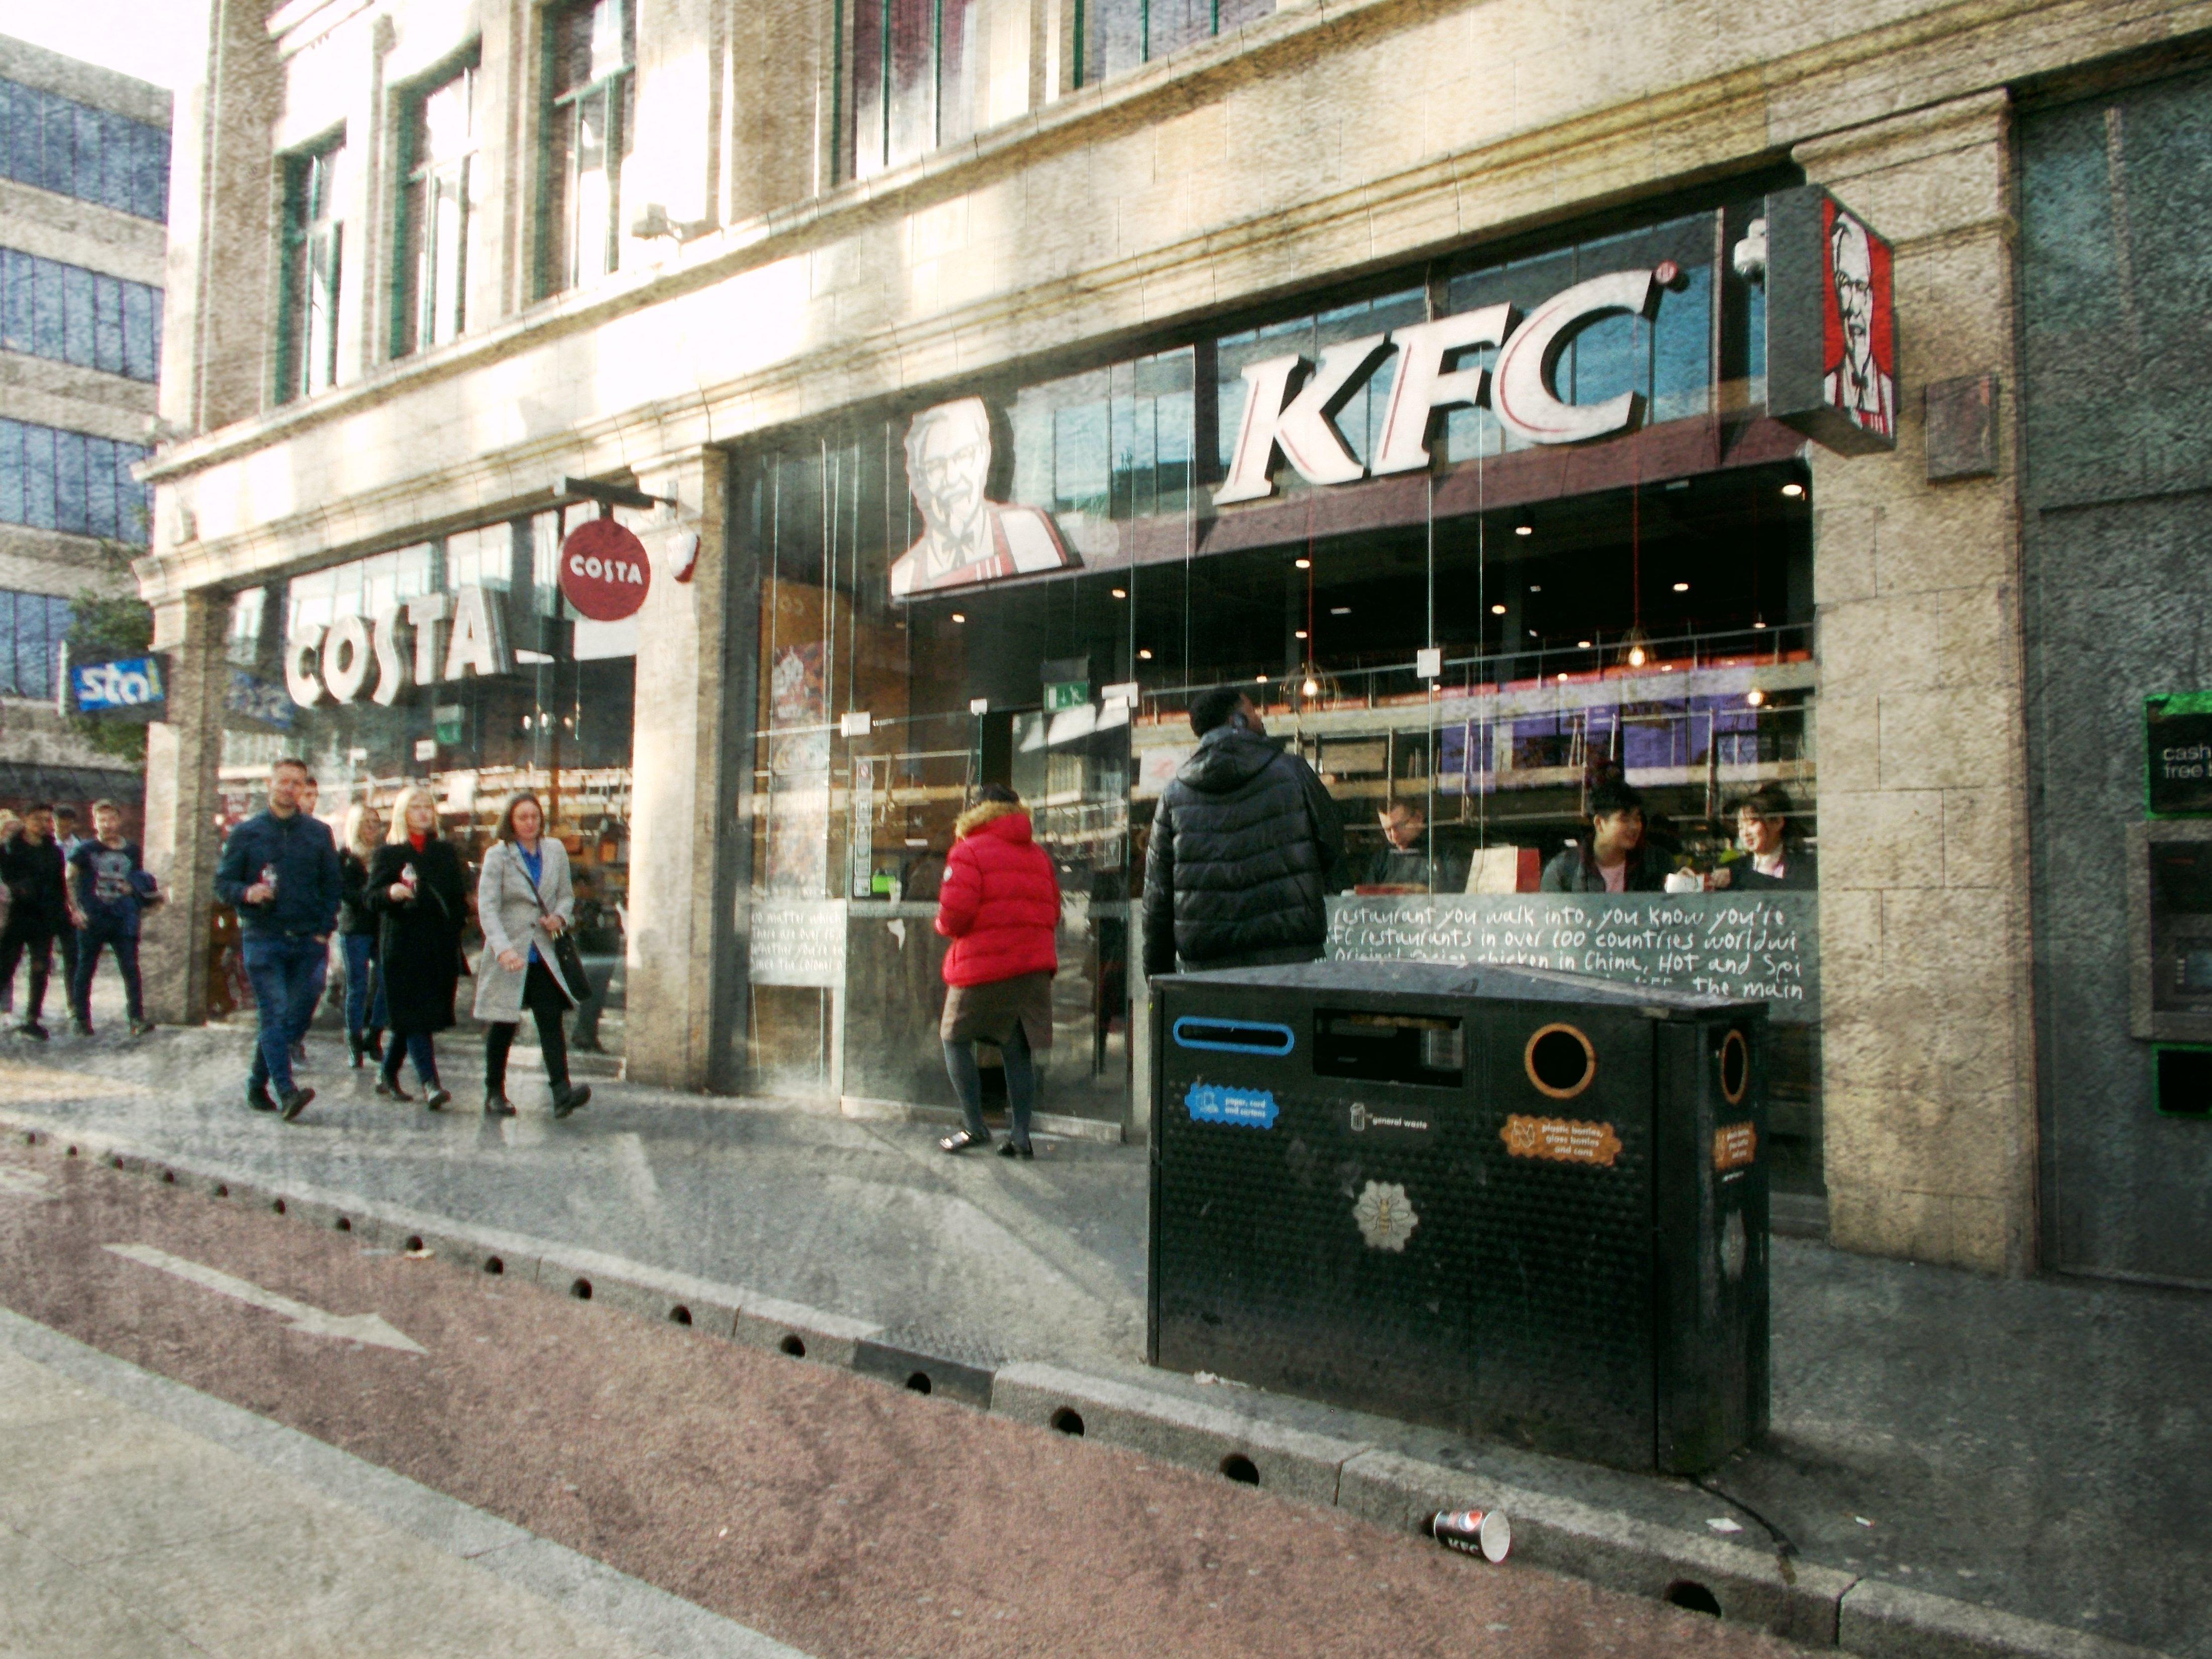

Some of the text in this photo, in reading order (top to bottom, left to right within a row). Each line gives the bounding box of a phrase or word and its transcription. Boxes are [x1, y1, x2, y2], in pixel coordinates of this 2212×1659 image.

[1213, 269, 1653, 506] KFC
[569, 554, 643, 585] COSTA
[285, 584, 496, 708] COSTA
[2164, 743, 2211, 761] cash
[2165, 763, 2203, 778] free
[767, 910, 803, 924] matter
[1334, 902, 1784, 934] restaurant you walk into, you know you're
[1360, 927, 1472, 947] restaurants
[1481, 927, 1496, 947] in
[1505, 928, 1544, 947] over
[1595, 929, 1694, 950] countries
[1704, 929, 1797, 952] worldwi
[1559, 950, 1575, 971] in
[1585, 950, 1649, 975] China,
[1708, 952, 1751, 975] and
[1692, 975, 1730, 996] the
[1743, 978, 1803, 1001] main
[1403, 1120, 1427, 1129] waste
[1541, 1123, 1569, 1134] plastic
[1546, 1134, 1600, 1147] glass bottles
[1554, 1145, 1593, 1157] and cans
